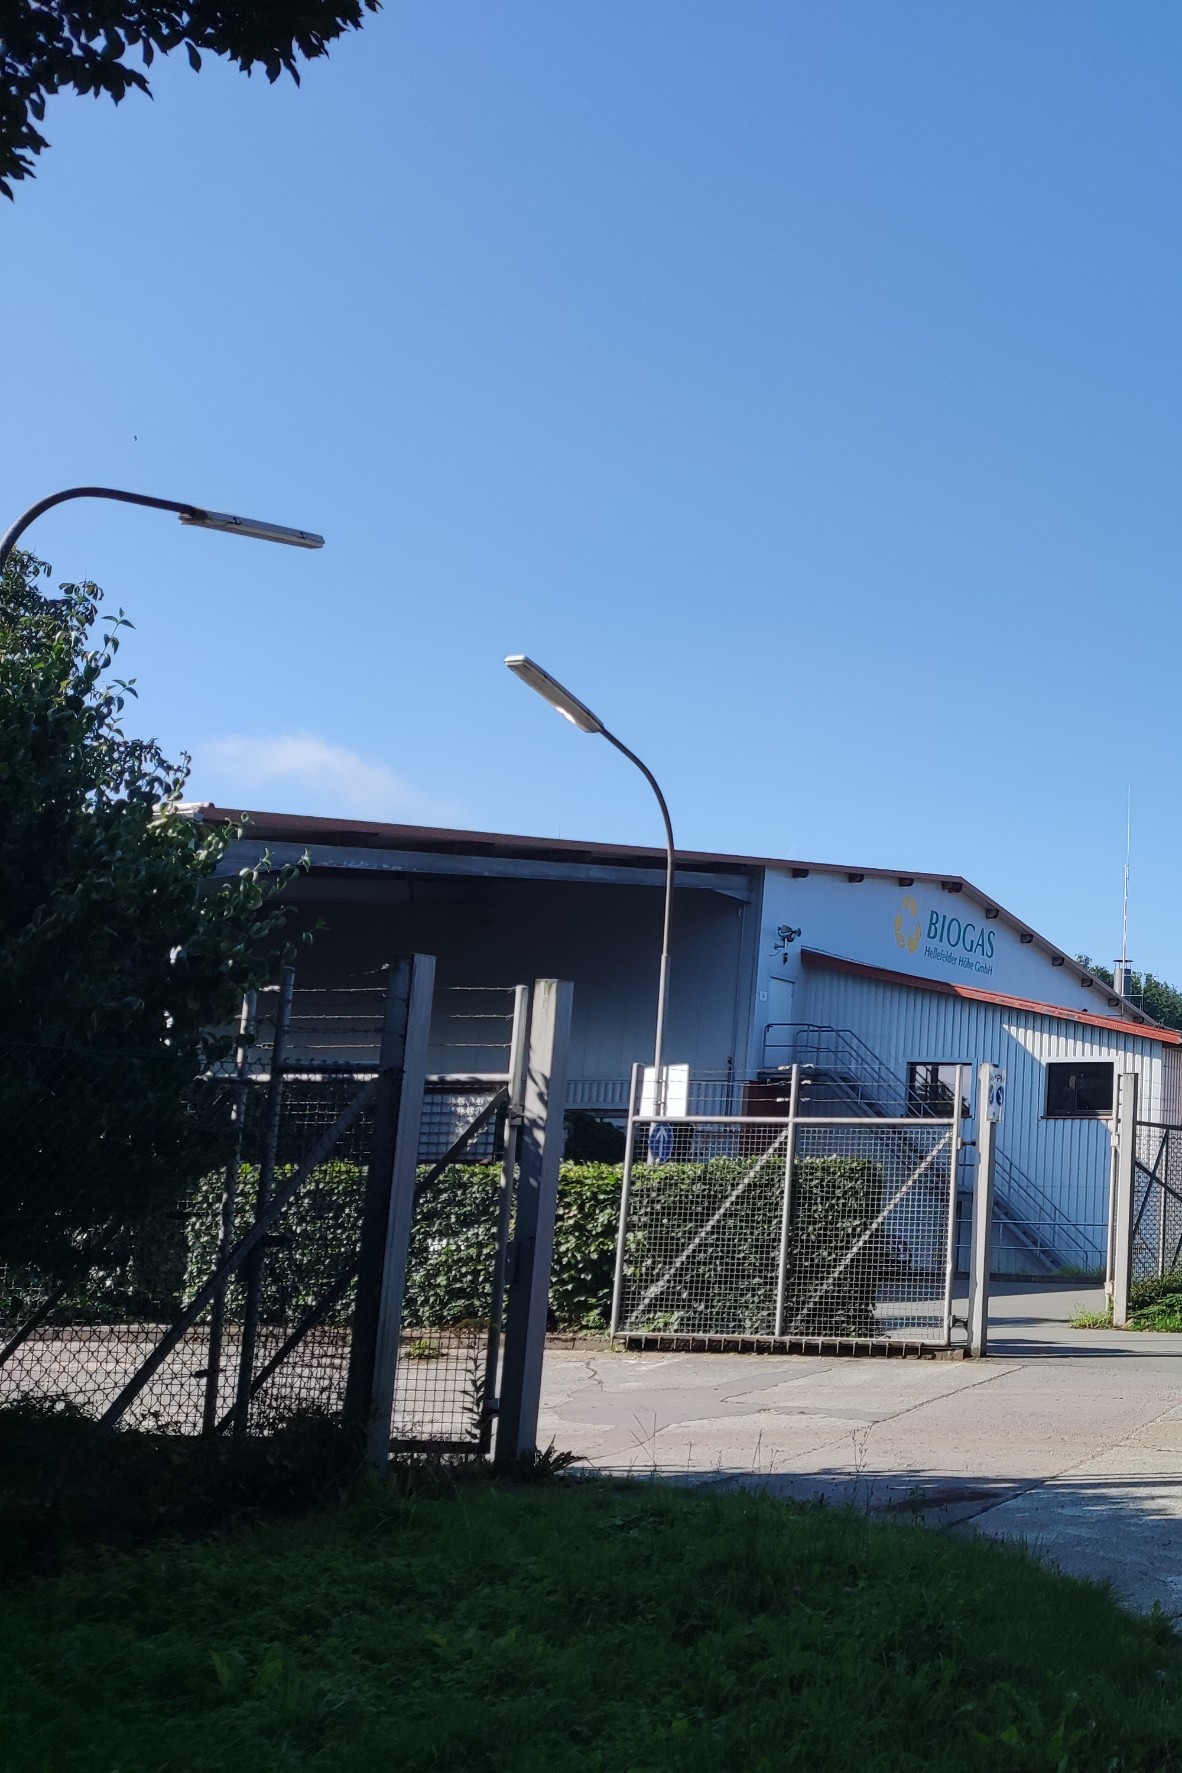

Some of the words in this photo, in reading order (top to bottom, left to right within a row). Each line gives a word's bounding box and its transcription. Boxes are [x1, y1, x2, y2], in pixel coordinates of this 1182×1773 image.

[926, 910, 996, 959] BIOGAS
[924, 945, 957, 965] Hellefelder
[958, 955, 974, 970] Höhe
[974, 961, 993, 976] GmbH
